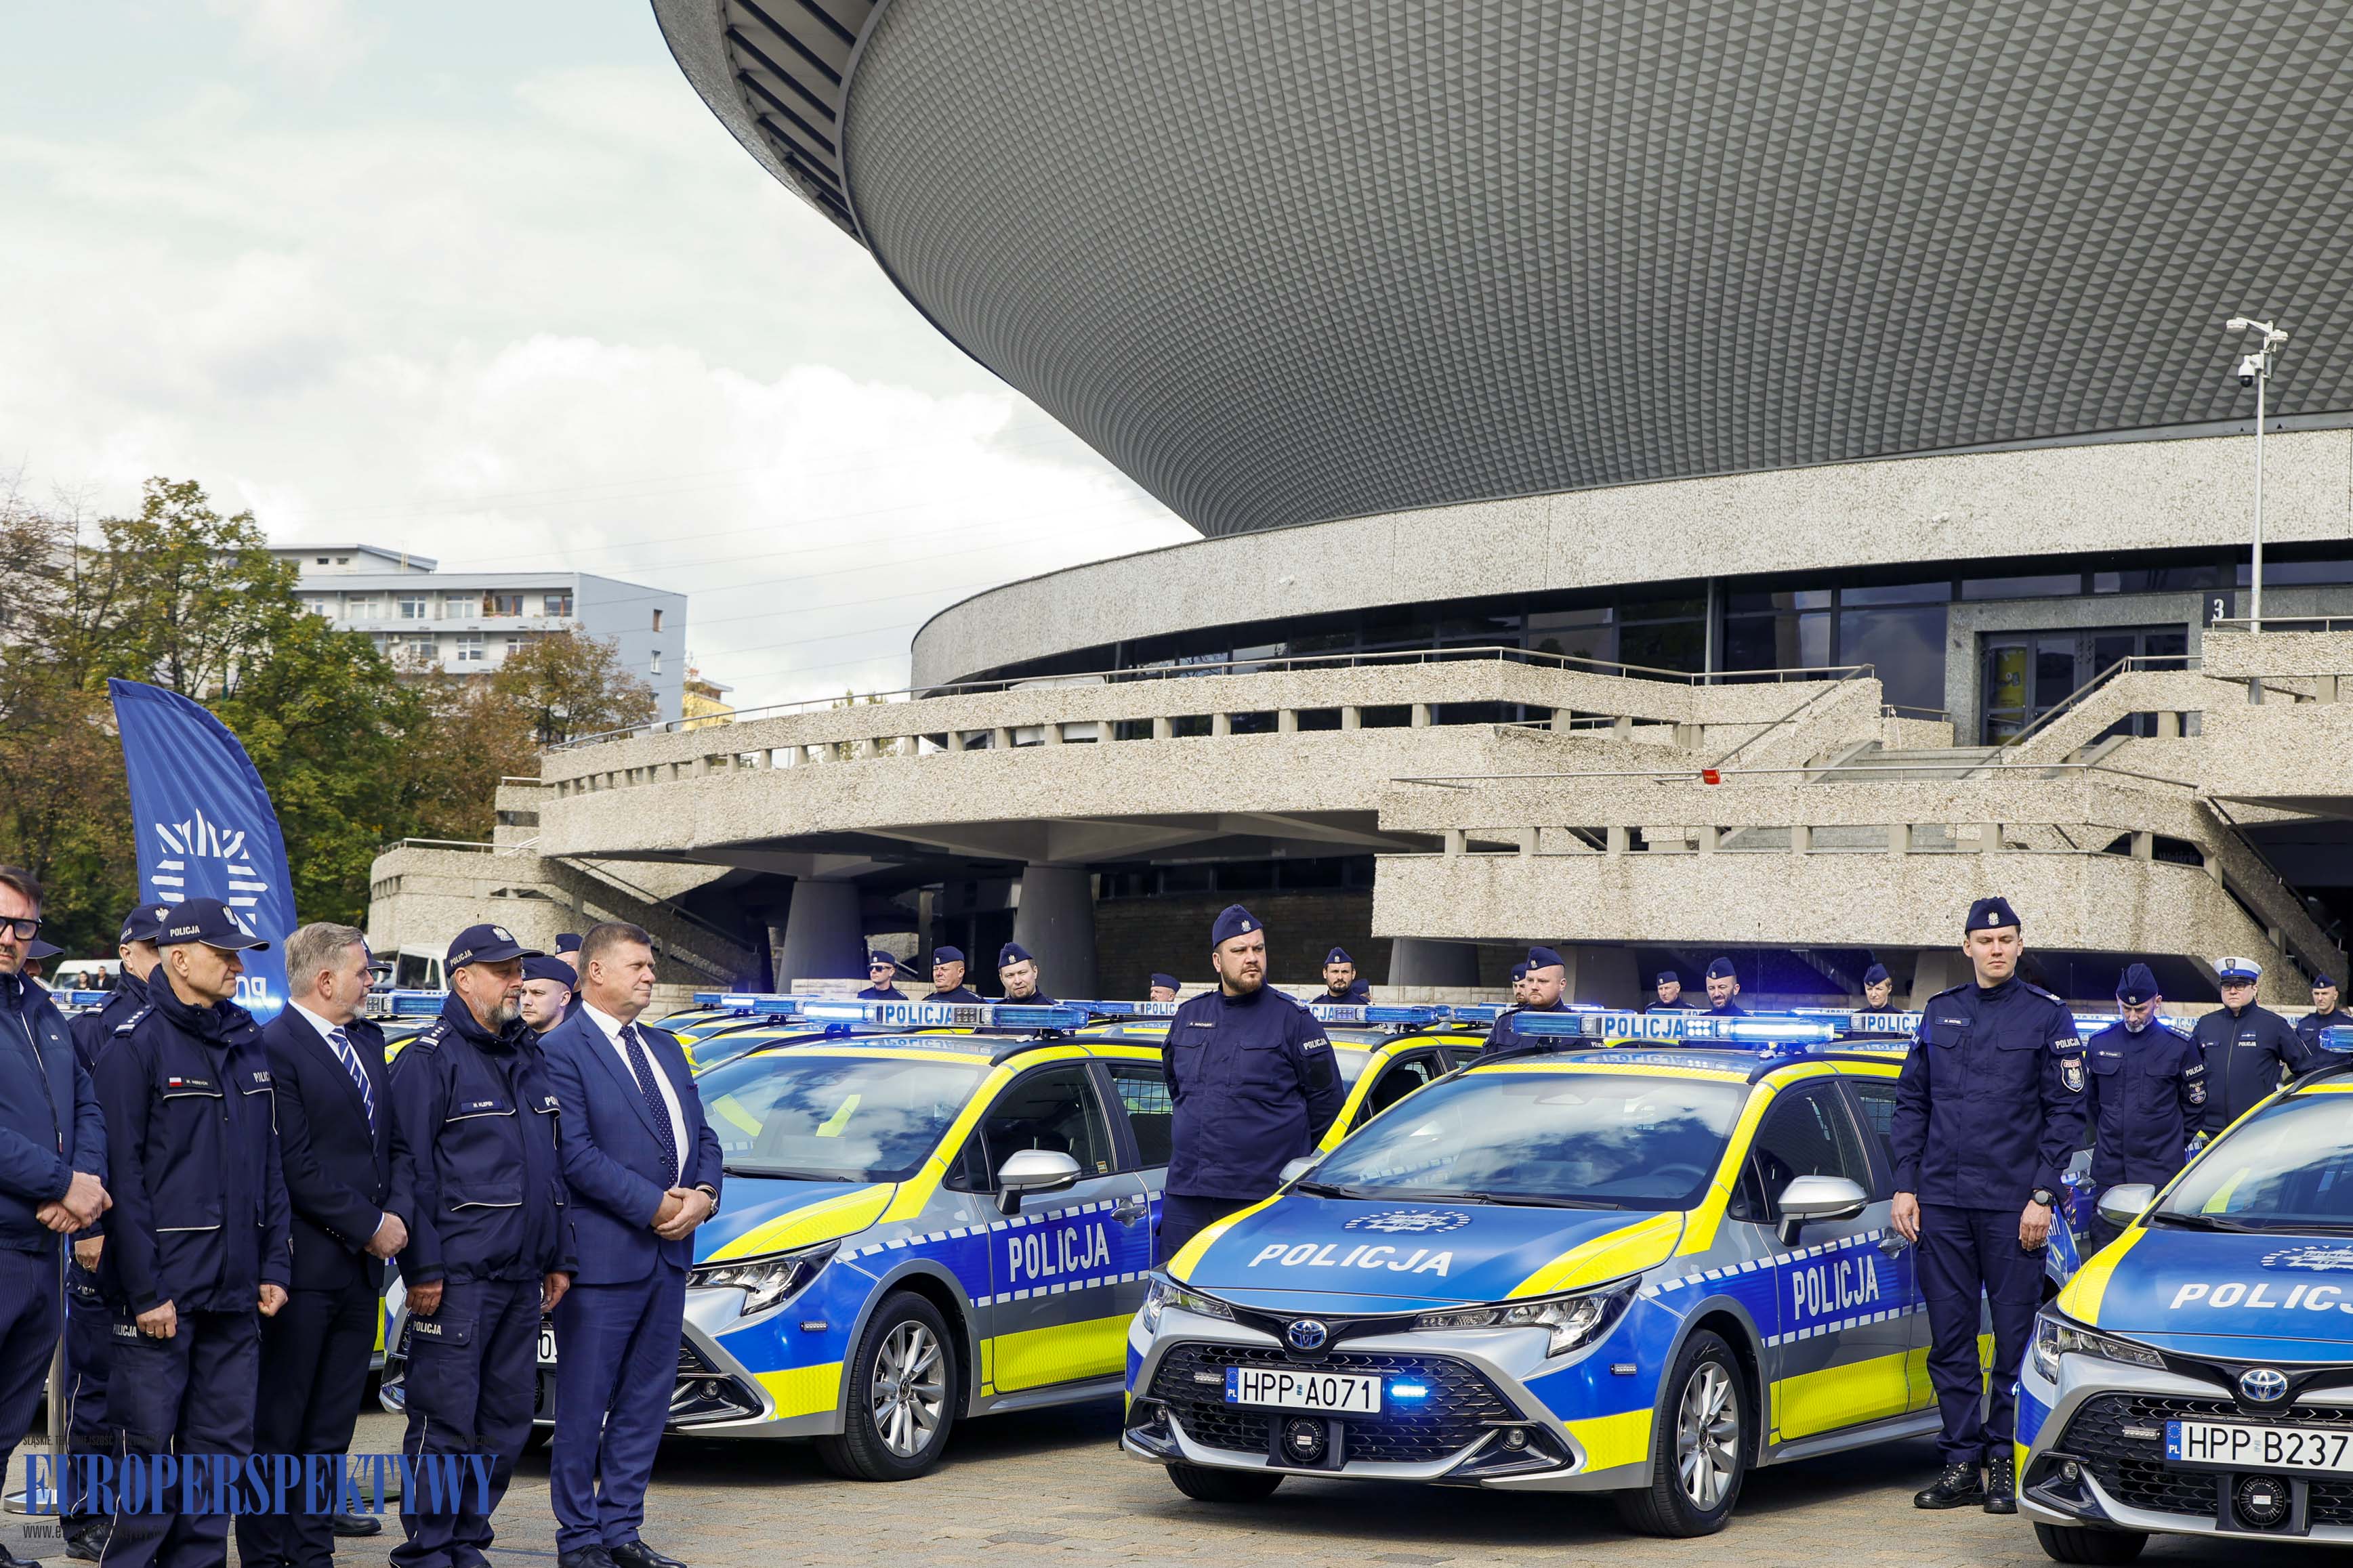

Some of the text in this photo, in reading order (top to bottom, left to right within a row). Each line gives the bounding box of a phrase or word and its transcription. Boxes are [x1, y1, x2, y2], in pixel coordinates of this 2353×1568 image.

[2213, 599, 2224, 620] 3
[169, 925, 201, 937] POLICJA
[450, 949, 473, 967] POLICJA
[886, 1005, 952, 1024] POLICJA
[1146, 1004, 1175, 1015] POLIC
[1605, 1017, 1684, 1038] POLICJA
[1868, 1016, 1919, 1032] POLICJ
[1303, 1038, 1327, 1050] POLICJA
[2055, 1038, 2081, 1049] POLICJA
[2186, 1064, 2204, 1077] POLICJA
[1008, 1223, 1110, 1282] POLICJA
[1247, 1243, 1454, 1277] POLICJA
[1792, 1254, 1879, 1320] POLICJA
[2169, 1283, 2353, 1314] POLIC
[413, 1320, 442, 1336] POLICJA
[1228, 1389, 1237, 1397] PL
[1244, 1372, 1370, 1409] HPP A071
[2168, 1445, 2180, 1454] PL
[2189, 1426, 2349, 1467] HPP B237
